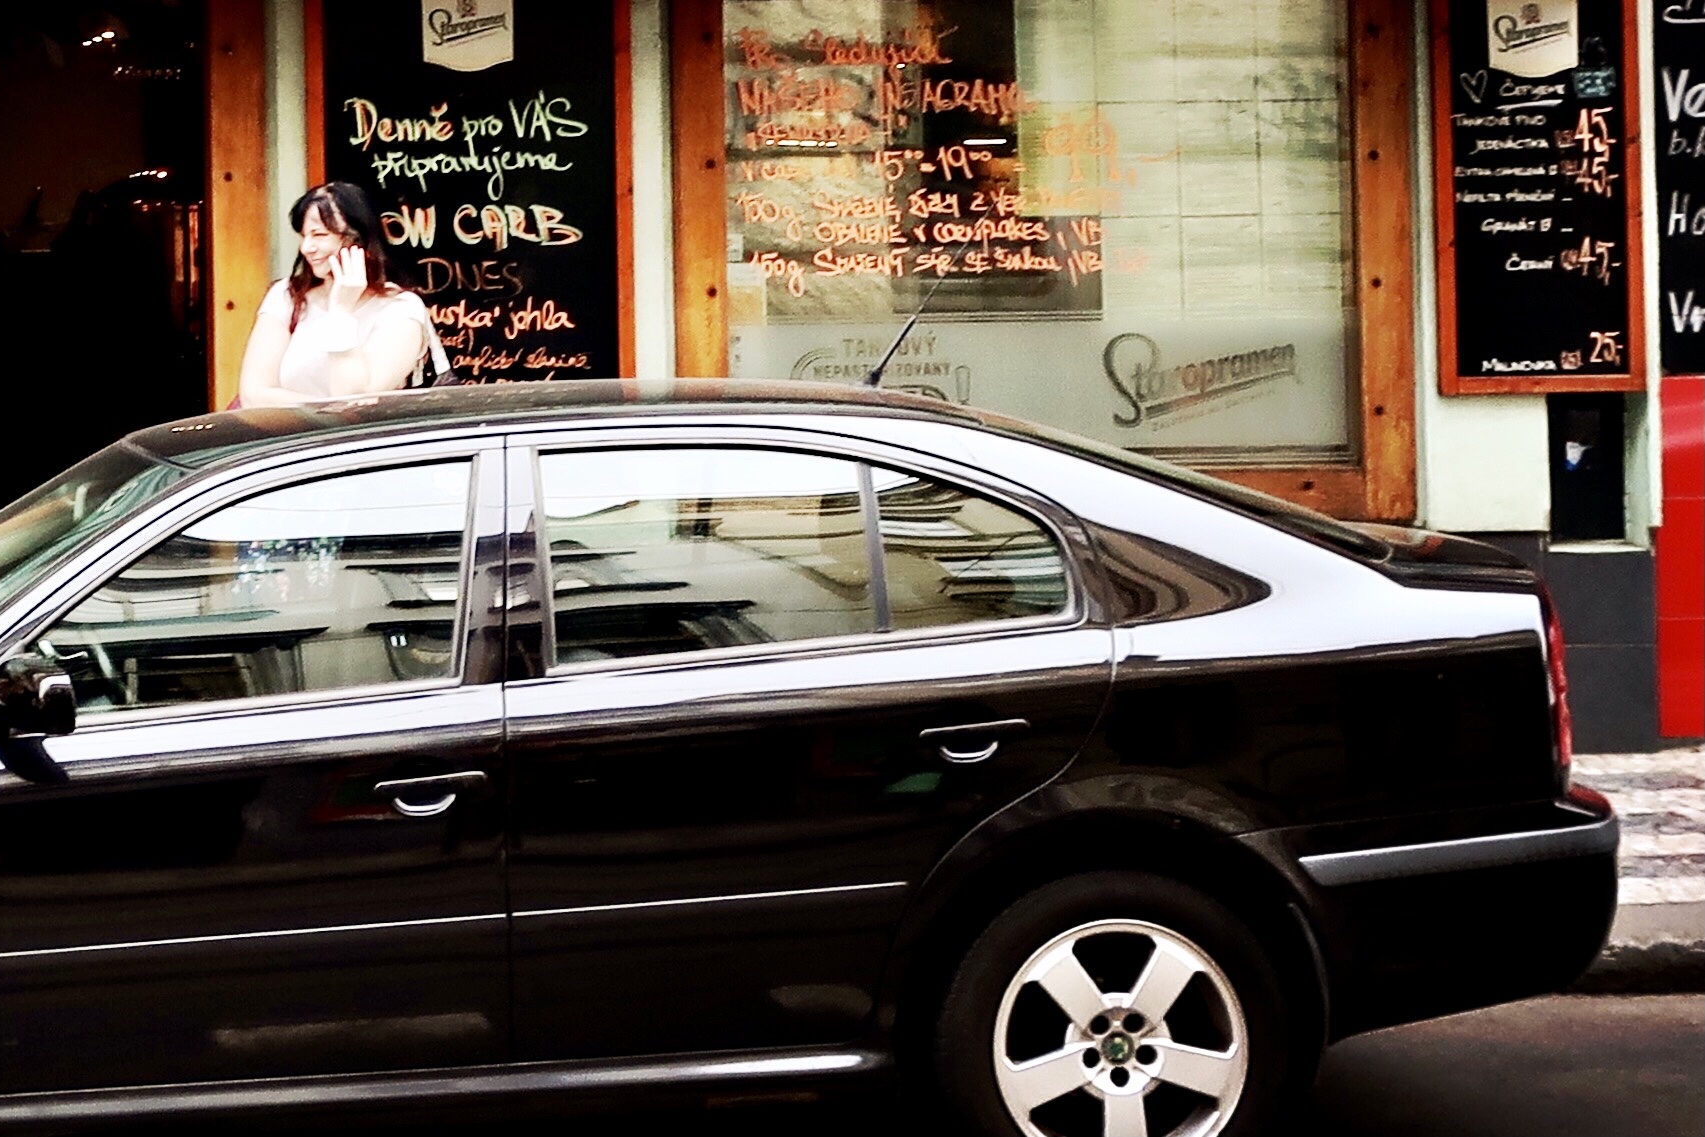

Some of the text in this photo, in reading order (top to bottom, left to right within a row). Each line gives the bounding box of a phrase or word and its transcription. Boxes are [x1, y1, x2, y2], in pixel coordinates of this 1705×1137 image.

[343, 90, 589, 156] Denně pro VÁS
[453, 204, 584, 251] CARB
